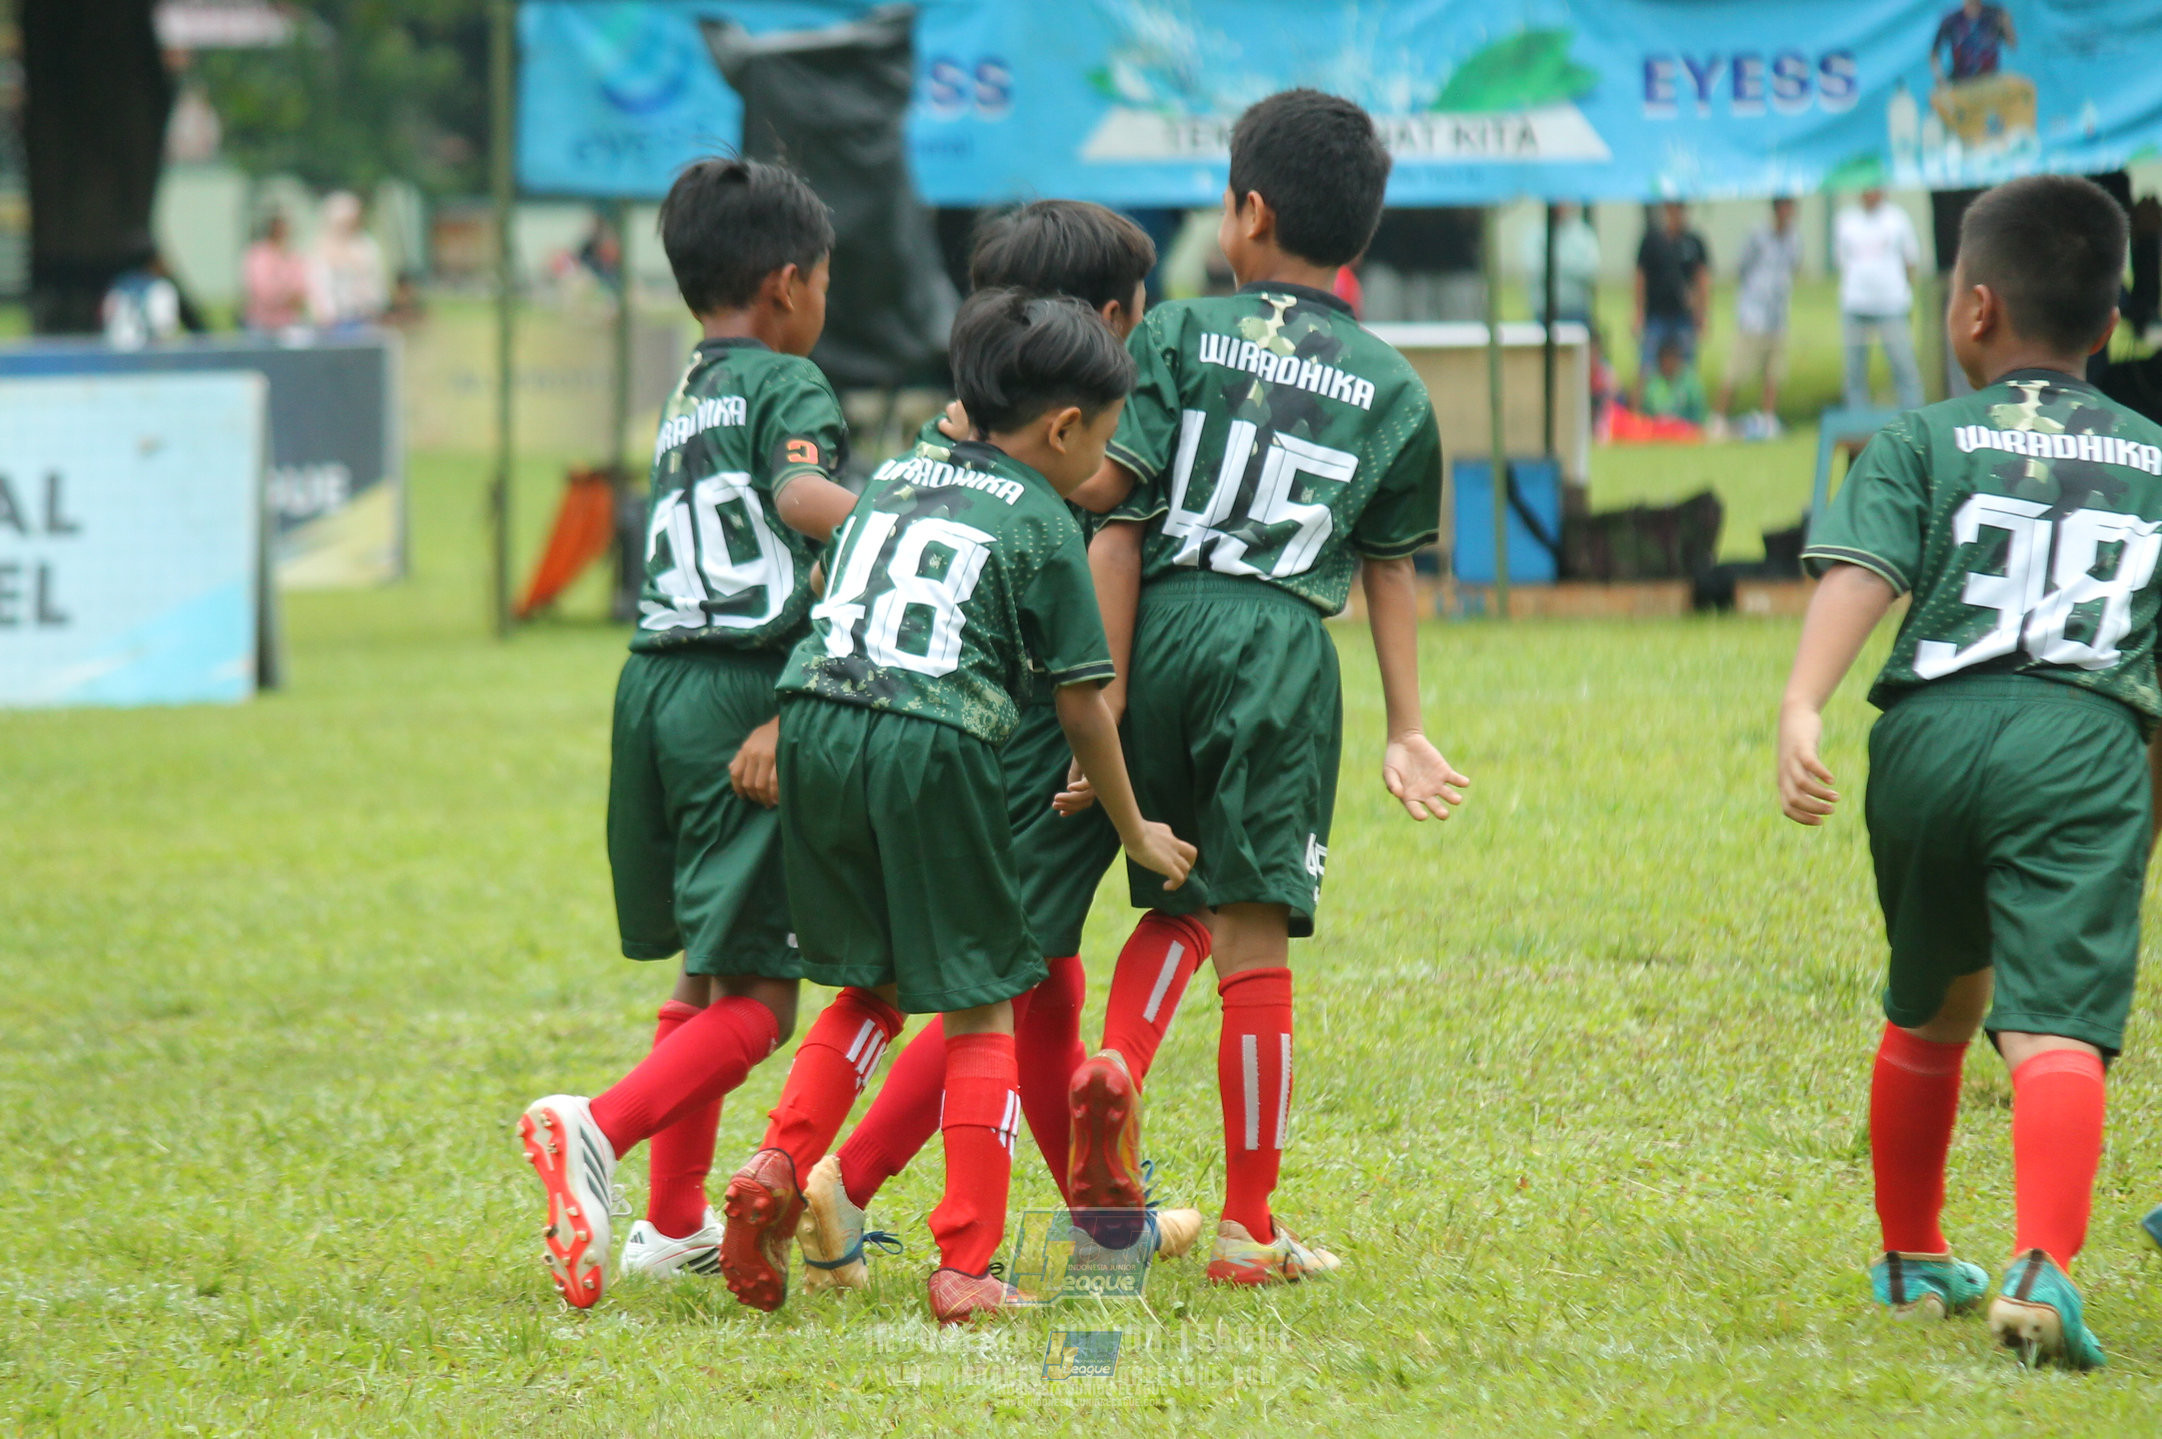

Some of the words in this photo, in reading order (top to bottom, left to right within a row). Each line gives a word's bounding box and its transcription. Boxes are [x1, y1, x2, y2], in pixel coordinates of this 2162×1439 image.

[1643, 50, 1858, 118] EYESS
[1199, 332, 1376, 411] WIRADHIKA
[1161, 408, 1359, 581] 45
[1953, 424, 2162, 476] WIRADHIKA
[810, 511, 998, 678] 48
[1912, 493, 2162, 680] 38
